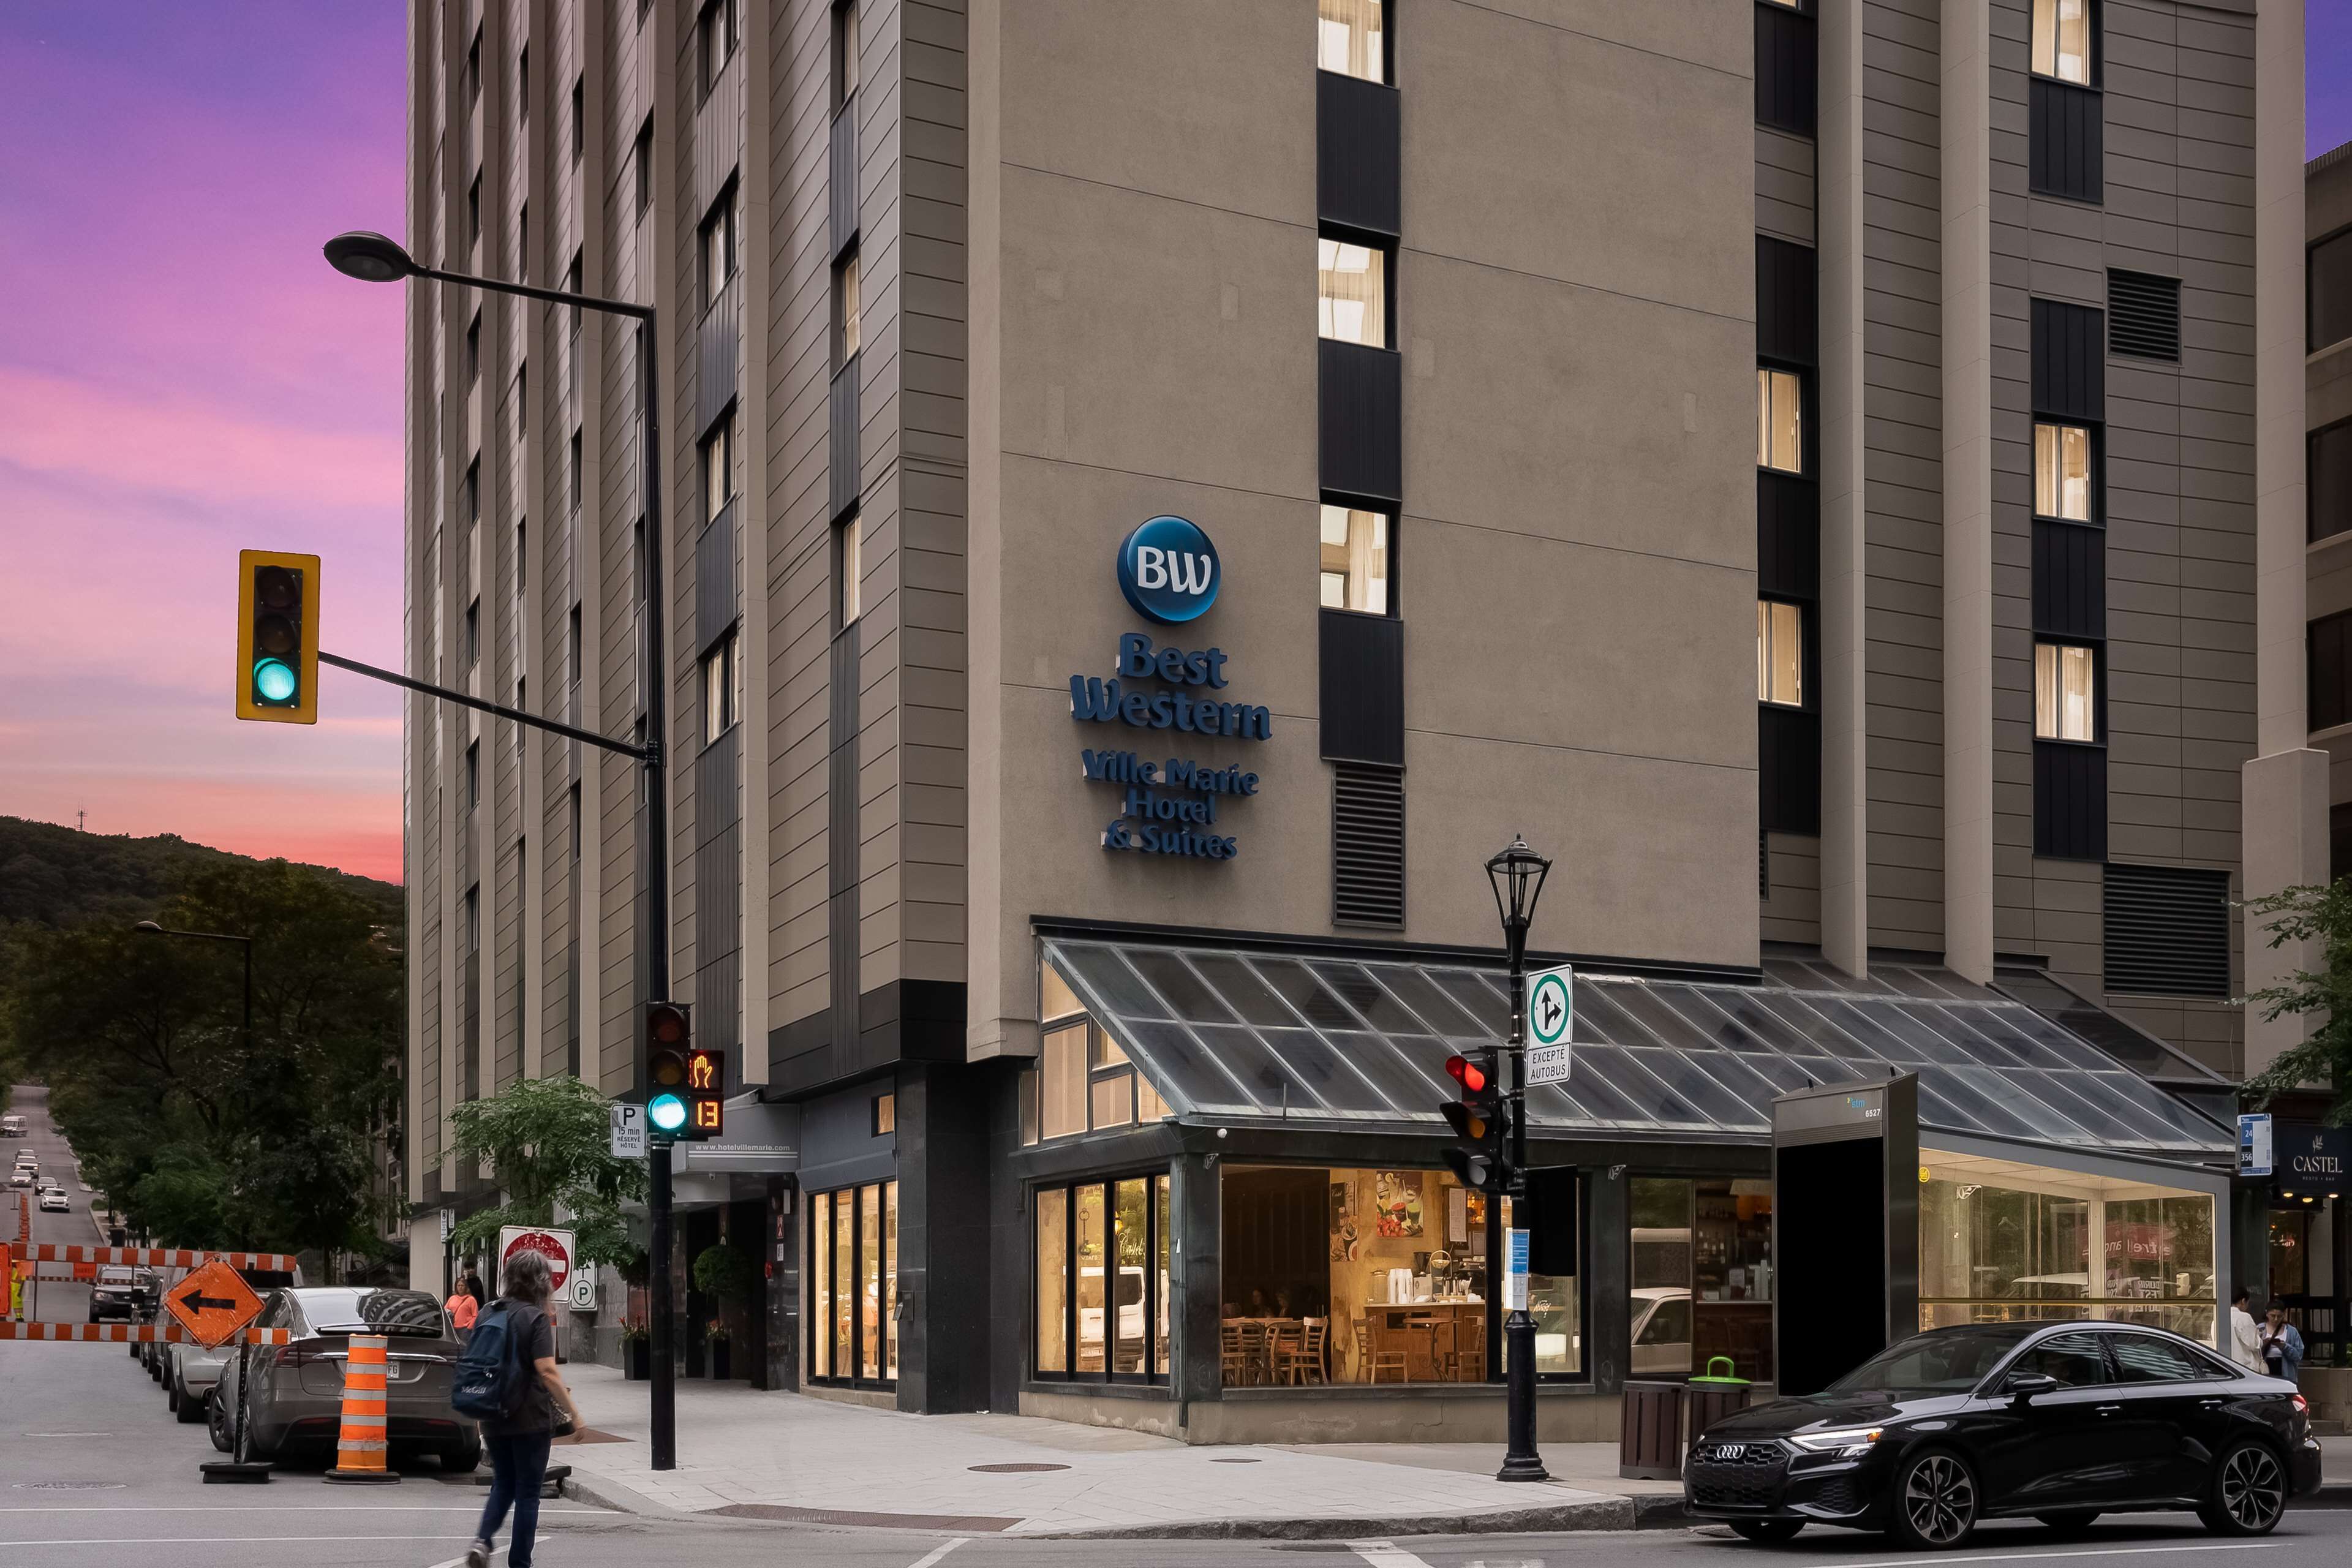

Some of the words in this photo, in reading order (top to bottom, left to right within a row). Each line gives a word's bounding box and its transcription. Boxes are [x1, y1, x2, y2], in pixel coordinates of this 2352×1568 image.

[1137, 546, 1212, 595] BW
[1119, 632, 1229, 690] Best
[1069, 674, 1273, 741] Western
[1081, 748, 1158, 786] Ville
[1166, 758, 1259, 795] Marie
[1126, 788, 1218, 825] Hotel
[1105, 819, 1133, 850] &
[1139, 825, 1237, 861] Suites
[1532, 1046, 1565, 1064] EXCEPTÉ
[1531, 1064, 1566, 1080] AUTOBUS
[623, 1107, 636, 1126] P
[698, 1101, 718, 1126] 13
[1865, 1109, 1881, 1118] 6527
[618, 1126, 625, 1135] 15
[2293, 1156, 2343, 1172] CASTEL
[579, 1287, 588, 1300] P
